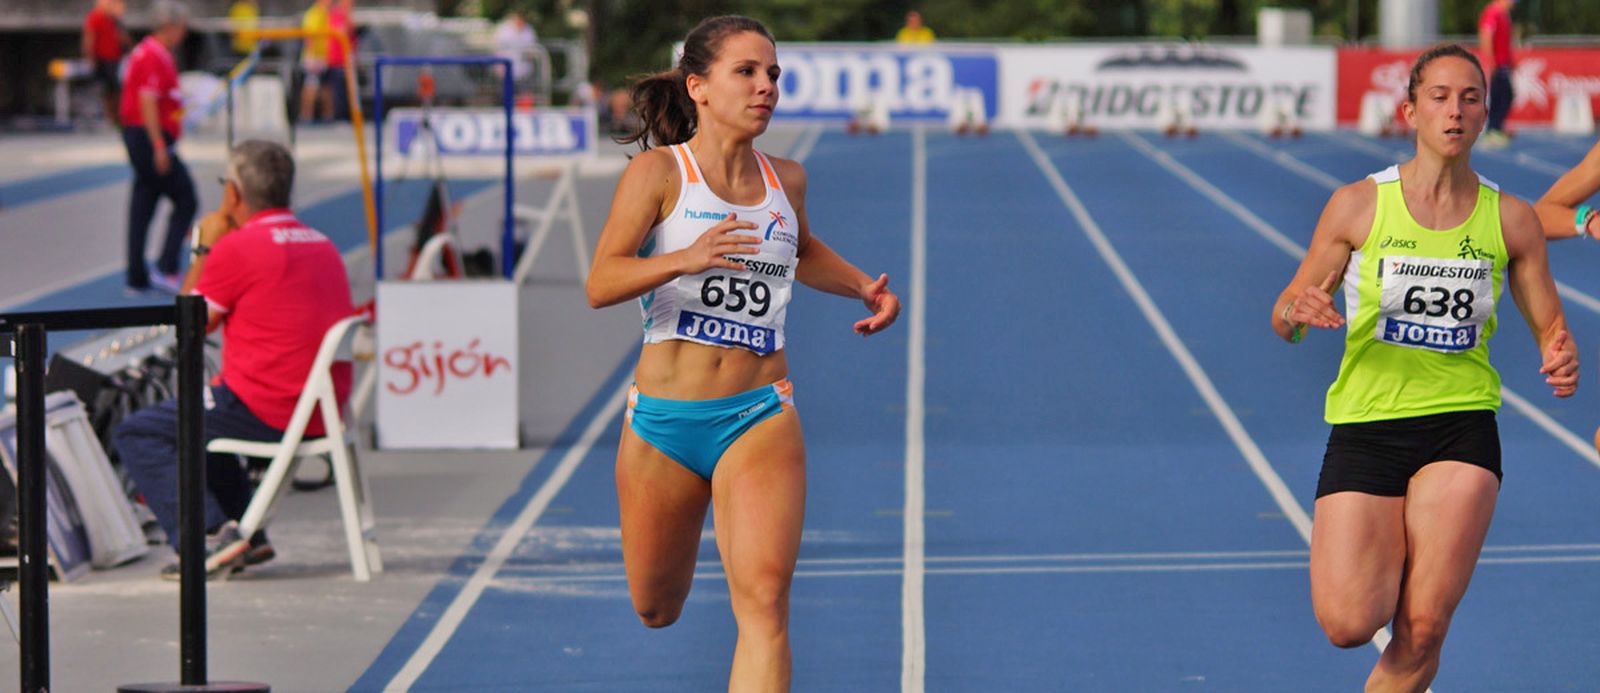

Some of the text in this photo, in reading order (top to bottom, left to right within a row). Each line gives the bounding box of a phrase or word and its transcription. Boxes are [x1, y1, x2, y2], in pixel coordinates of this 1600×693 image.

[778, 52, 955, 112] oma
[427, 111, 577, 150] oma
[684, 207, 732, 221] humme
[1392, 262, 1488, 280] BRIDGESTONE
[701, 275, 771, 317] 659
[1403, 286, 1475, 321] 638
[384, 339, 512, 397] gijón
